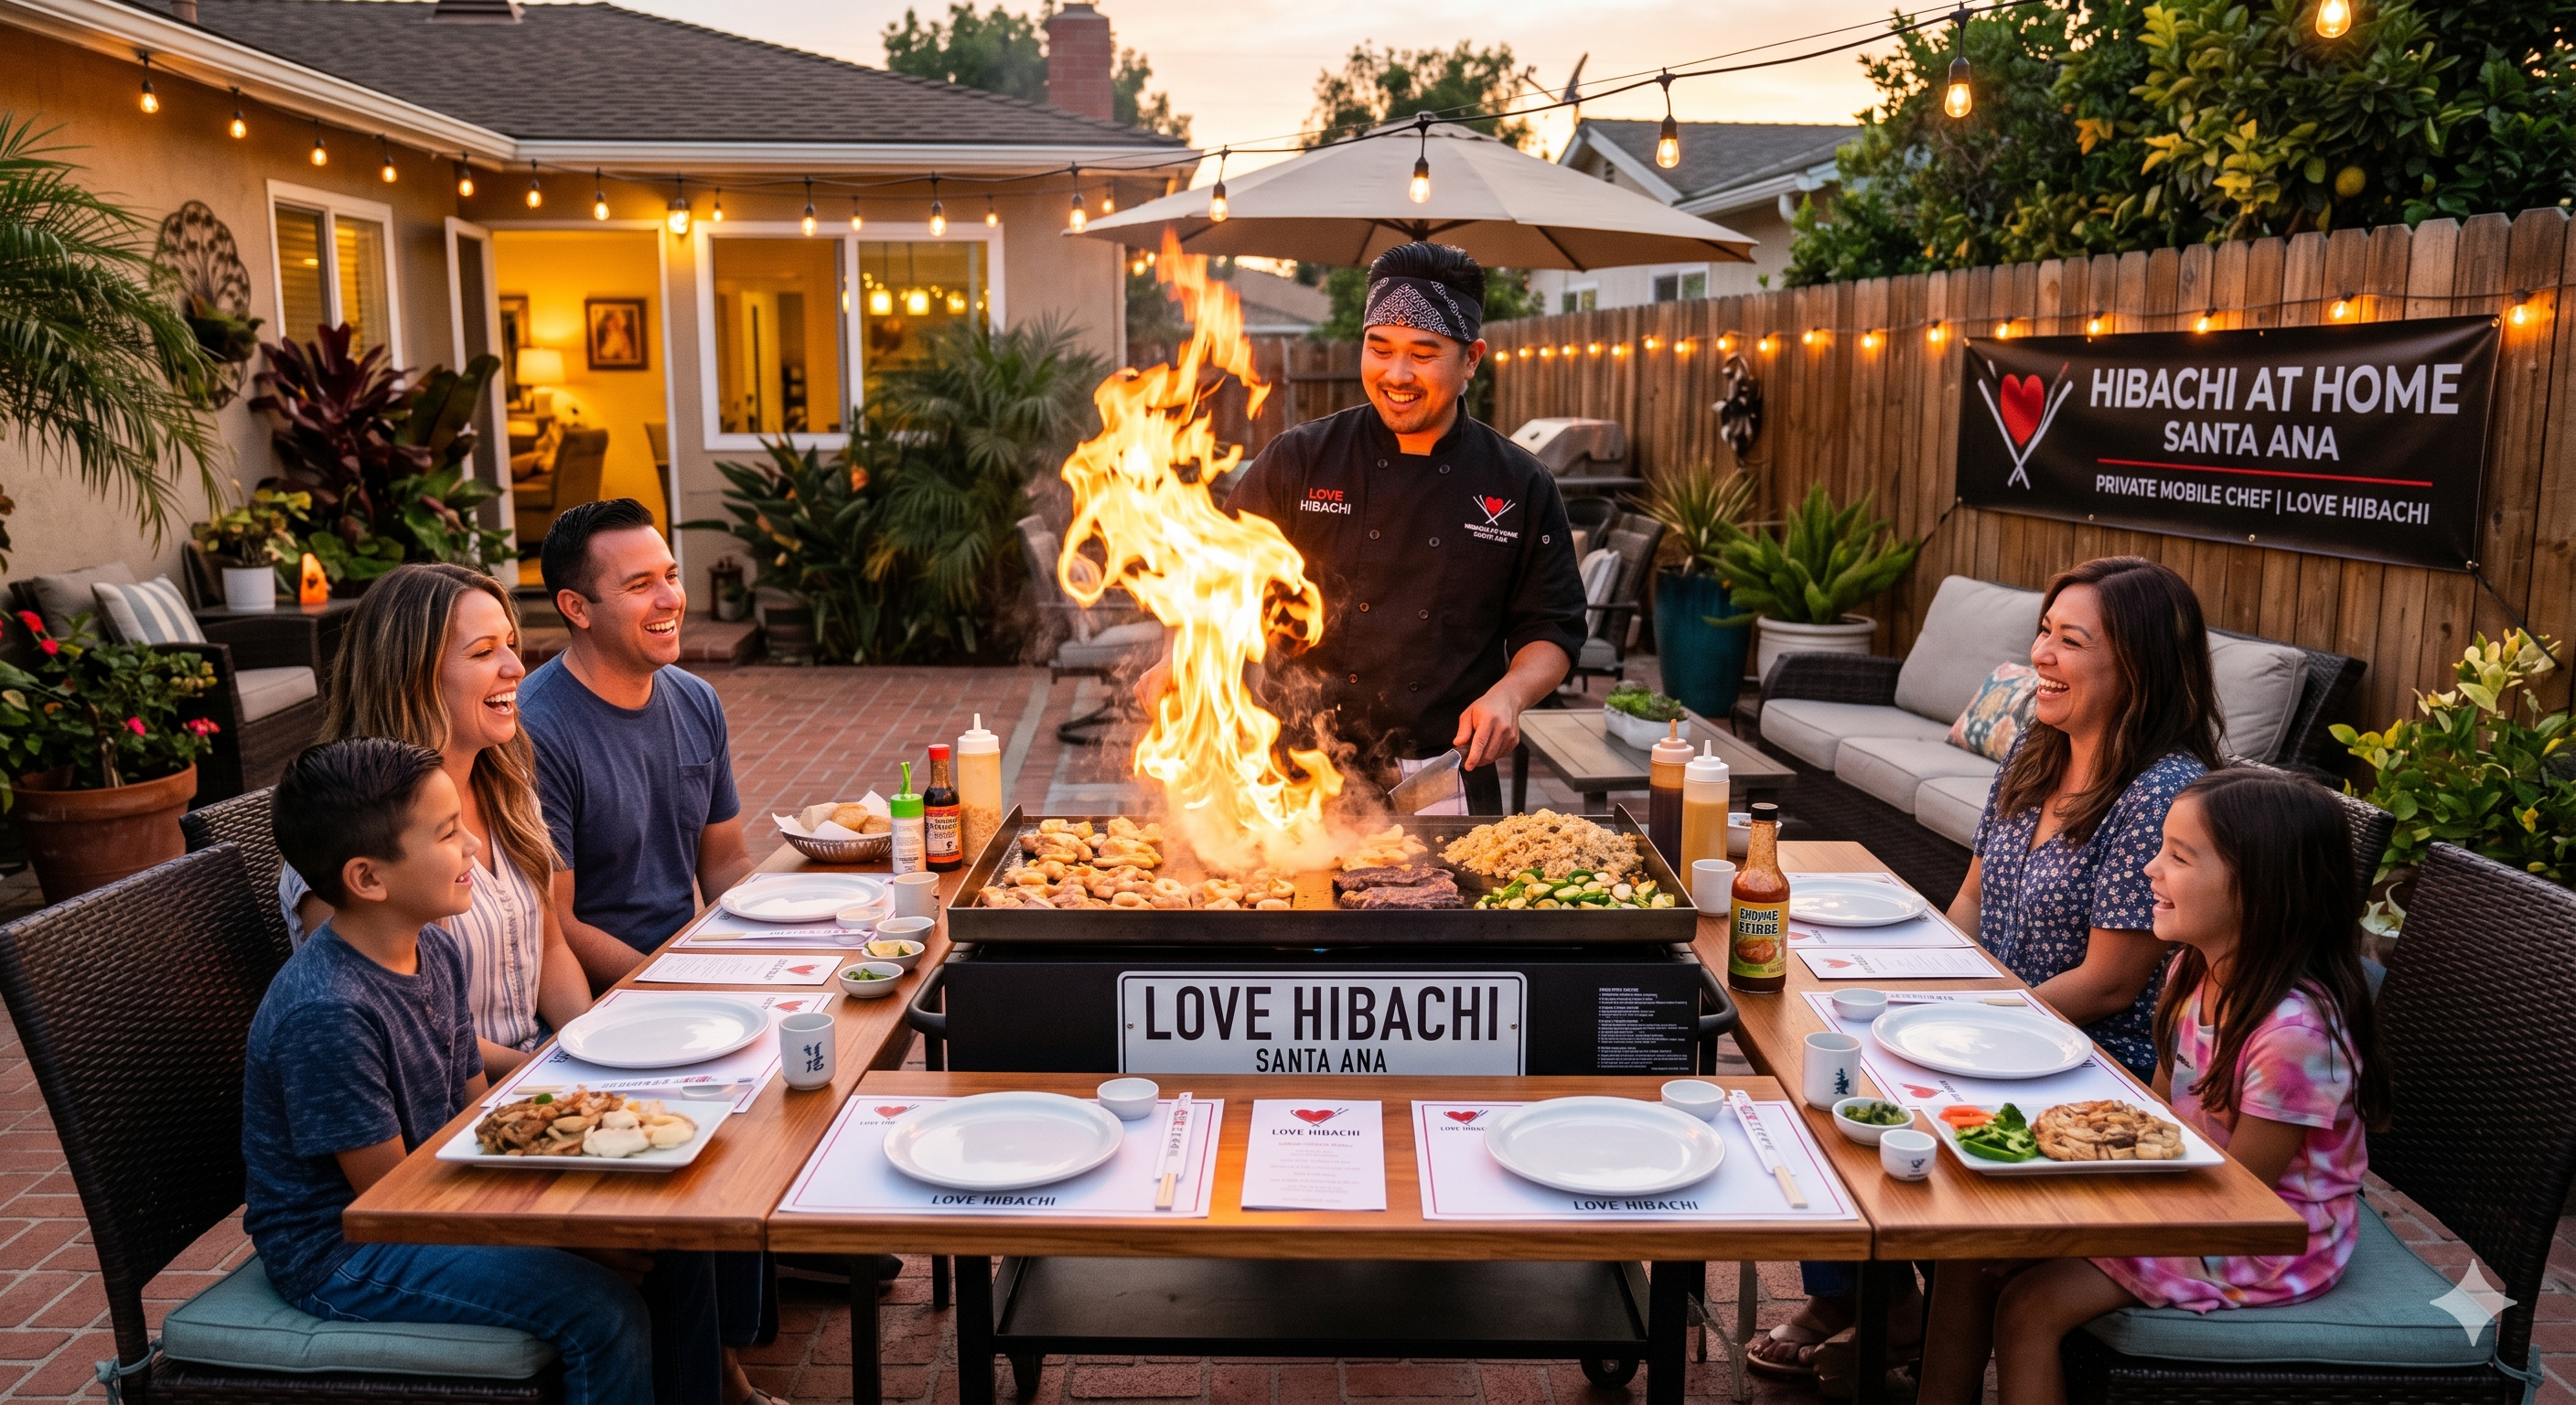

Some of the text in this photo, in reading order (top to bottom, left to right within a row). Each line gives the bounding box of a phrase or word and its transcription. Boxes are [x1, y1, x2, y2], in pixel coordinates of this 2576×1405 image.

[2089, 363, 2463, 414] HIBACHI AT HOME
[2163, 420, 2339, 461] SANTA ANA
[1308, 488, 1344, 502] LOVE
[2096, 474, 2156, 498] PRIVATE
[2160, 480, 2221, 504] MOBILE
[2225, 487, 2272, 509] CHEF
[2286, 491, 2338, 516] LOVE
[2342, 496, 2430, 525] HIBACHI
[1299, 499, 1352, 515] HIBACHI
[1145, 985, 1498, 1041] LOVE HIBACHI
[1256, 1047, 1388, 1073] SANTA ANA
[1308, 1129, 1360, 1137] HIBACHI
[931, 1195, 1056, 1207] LOVE HIBACHI
[1573, 1200, 1699, 1211] LOVE HIBACHI
